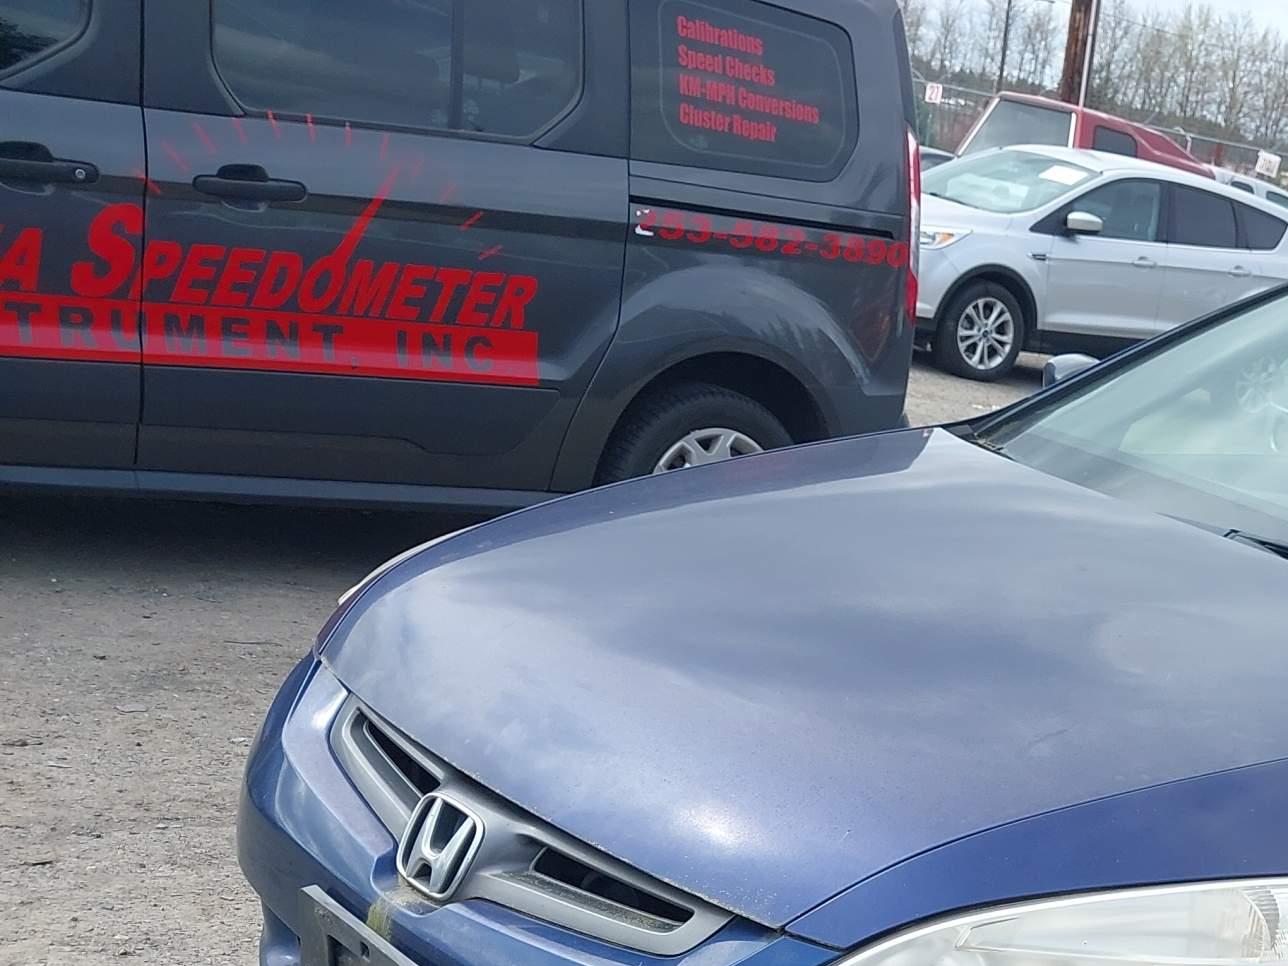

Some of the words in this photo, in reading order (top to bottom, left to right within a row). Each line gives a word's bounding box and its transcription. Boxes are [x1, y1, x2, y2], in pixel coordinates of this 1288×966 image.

[676, 15, 764, 56] Calibrations
[677, 44, 723, 74] Speed
[725, 55, 776, 87] Checks
[679, 73, 736, 105] KM-MPH
[738, 87, 820, 124] Conversions
[679, 103, 731, 133] Cluster
[732, 114, 777, 142] Repair
[0, 224, 43, 291] A
[634, 208, 908, 268] 253-582-3890
